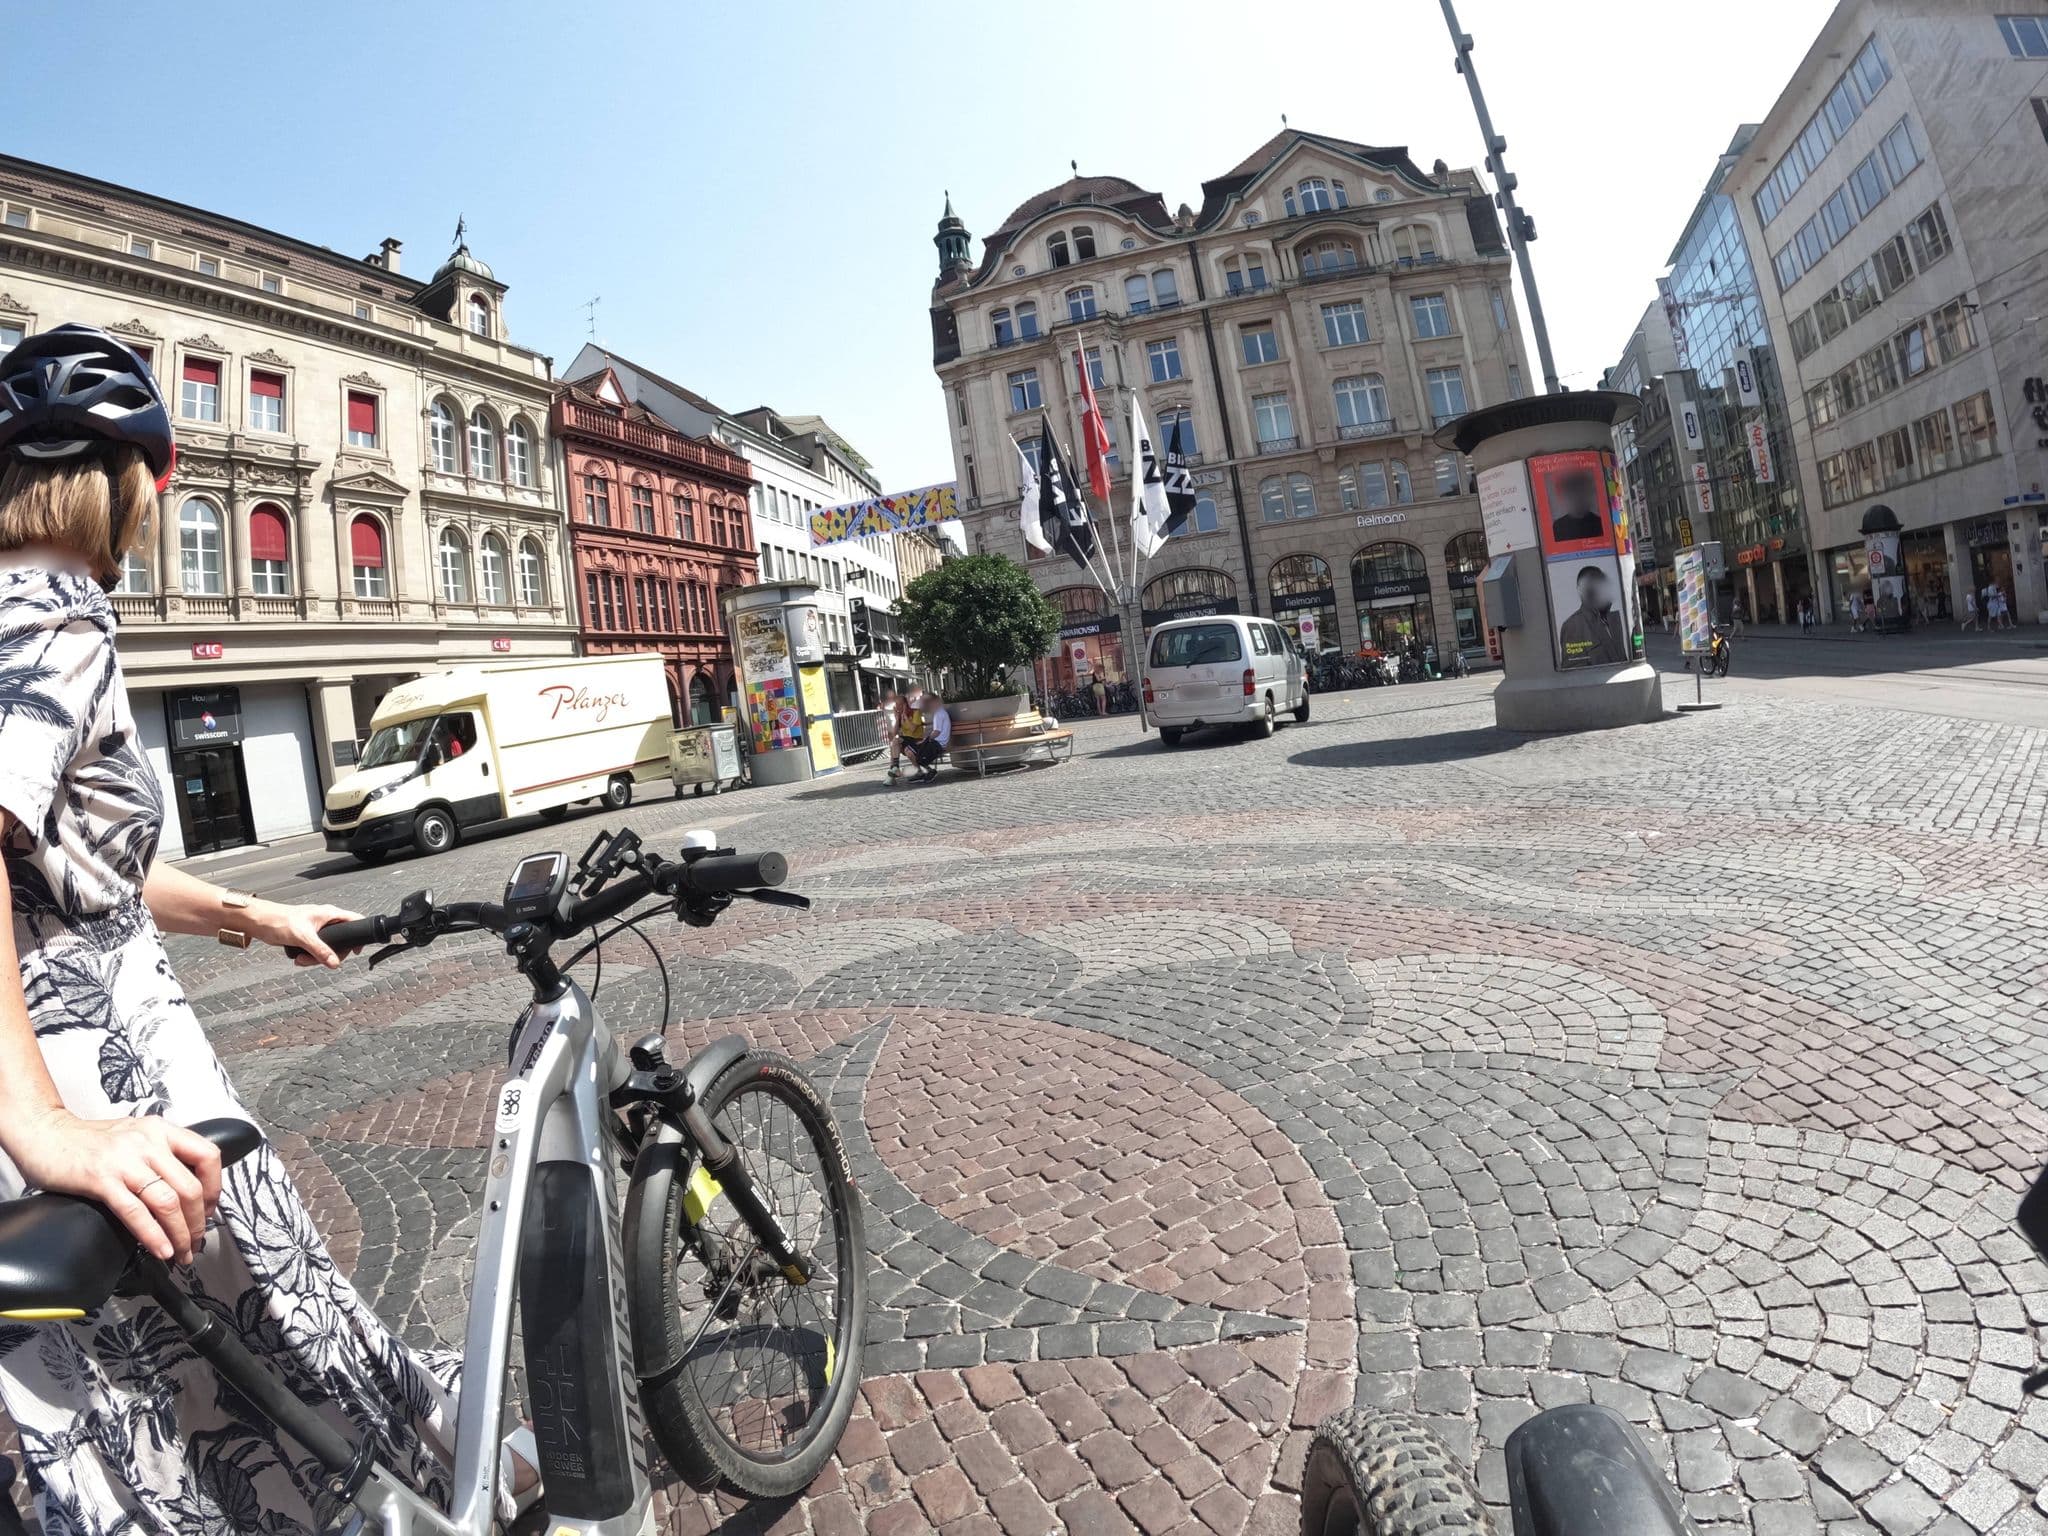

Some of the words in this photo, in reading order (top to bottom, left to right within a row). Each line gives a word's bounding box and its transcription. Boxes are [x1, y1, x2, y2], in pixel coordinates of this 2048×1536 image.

[1758, 448, 1769, 480] coop
[1357, 513, 1406, 527] fielmann
[1174, 608, 1217, 620] SWAROVSKI
[1060, 625, 1100, 638] SWAROVSKI
[196, 644, 221, 656] CIC
[493, 640, 510, 649] CIC
[538, 685, 631, 723] Planzer
[194, 730, 229, 740] swisscom
[768, 1066, 822, 1106] HUTCHINSON
[825, 1120, 853, 1183] PYTHON
